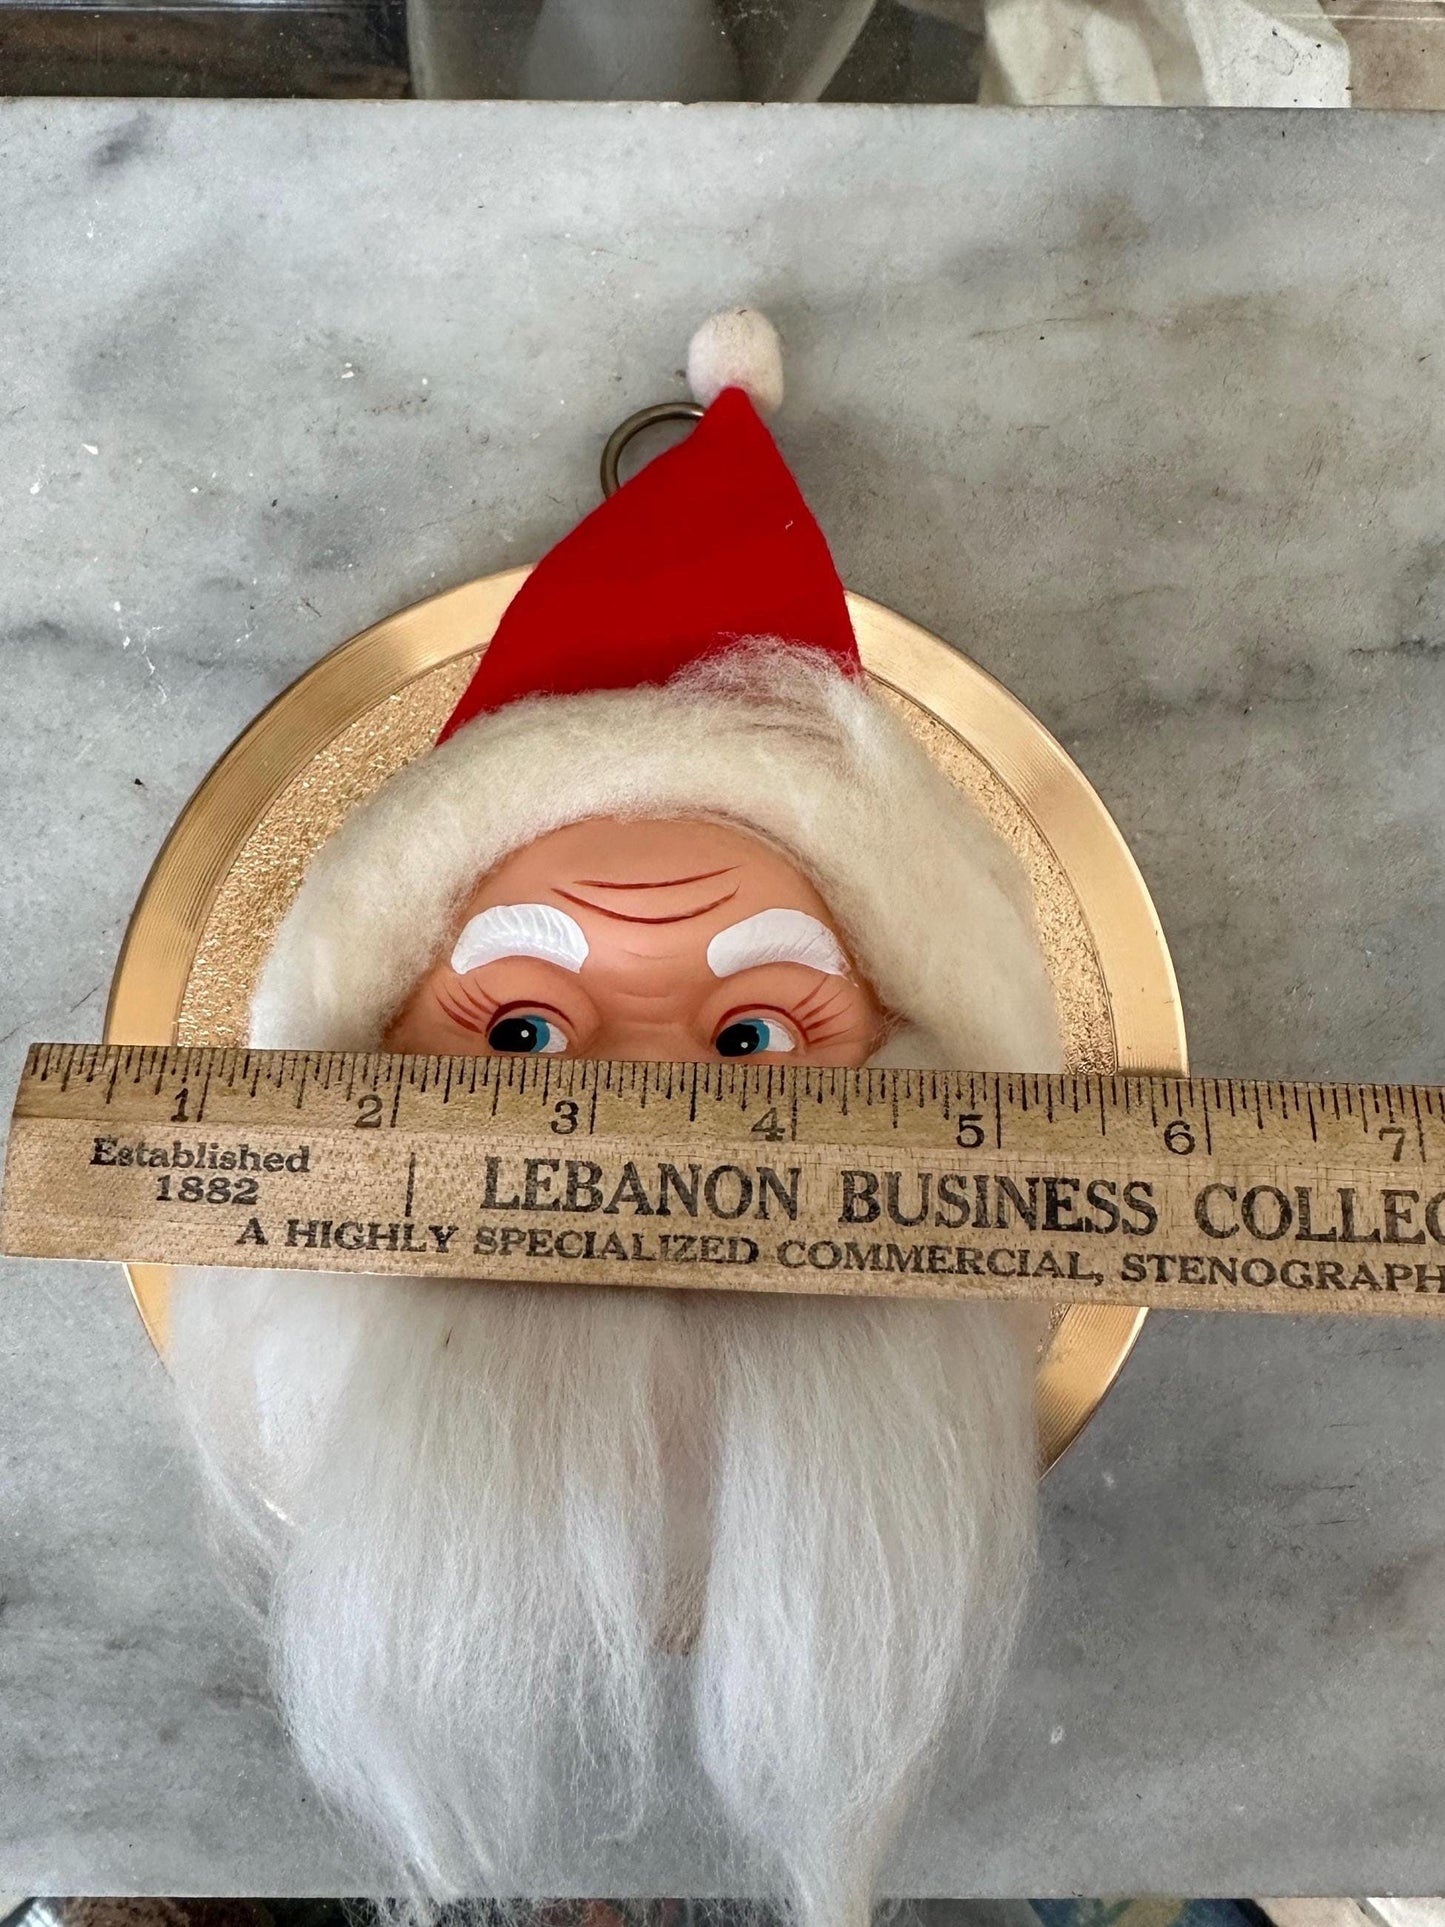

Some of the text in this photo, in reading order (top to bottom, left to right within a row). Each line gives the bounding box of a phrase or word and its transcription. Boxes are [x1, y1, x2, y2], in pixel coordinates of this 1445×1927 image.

[89, 1137, 311, 1173] Established
[171, 1088, 1406, 1162] 1 2 3 4 5 6 7
[156, 1174, 260, 1205] 1882
[480, 1156, 799, 1221] LEBANON
[838, 1169, 1159, 1236] BUSINESS
[236, 1217, 269, 1246] A
[284, 1219, 458, 1253] HIGHLY
[473, 1226, 760, 1266] SPECIALIZED
[776, 1238, 1105, 1287] COMMERCIAL,
